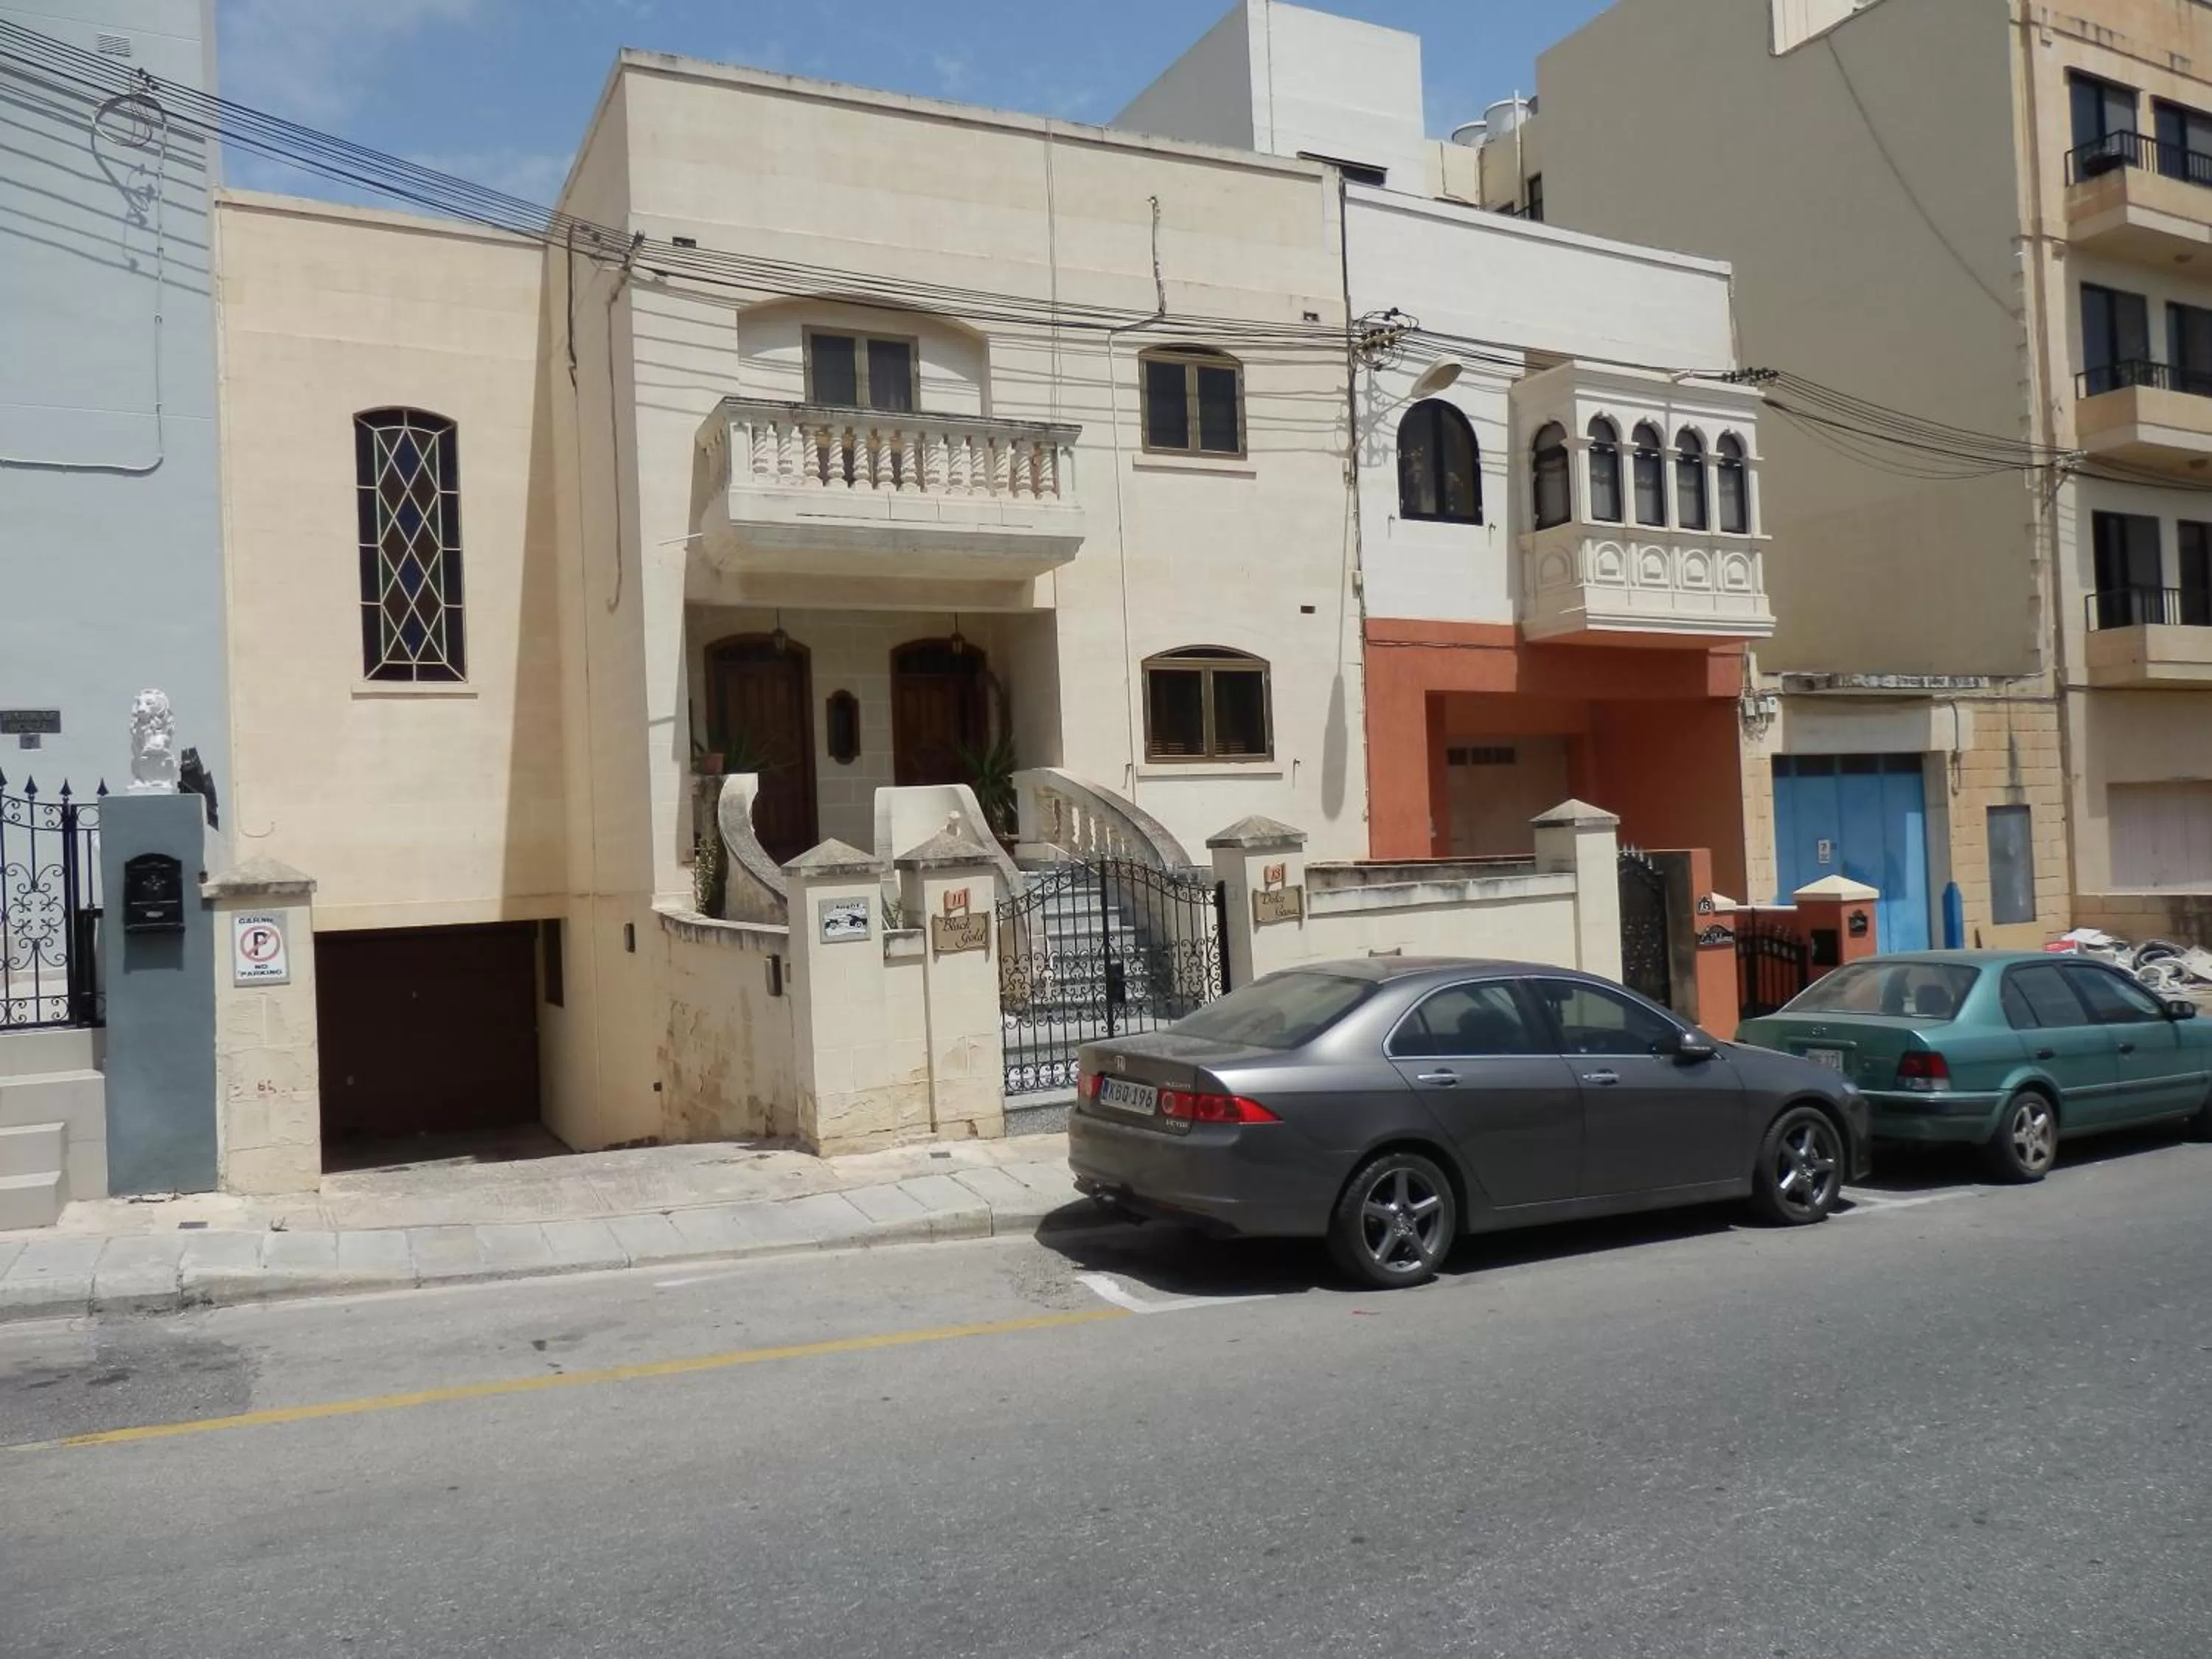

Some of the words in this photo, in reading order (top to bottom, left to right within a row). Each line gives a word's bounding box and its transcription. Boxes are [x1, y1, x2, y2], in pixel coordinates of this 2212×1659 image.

[943, 917, 972, 933] Black
[955, 927, 987, 949] Gold
[240, 969, 283, 977] PARKING
[1131, 1087, 1152, 1108] 196
